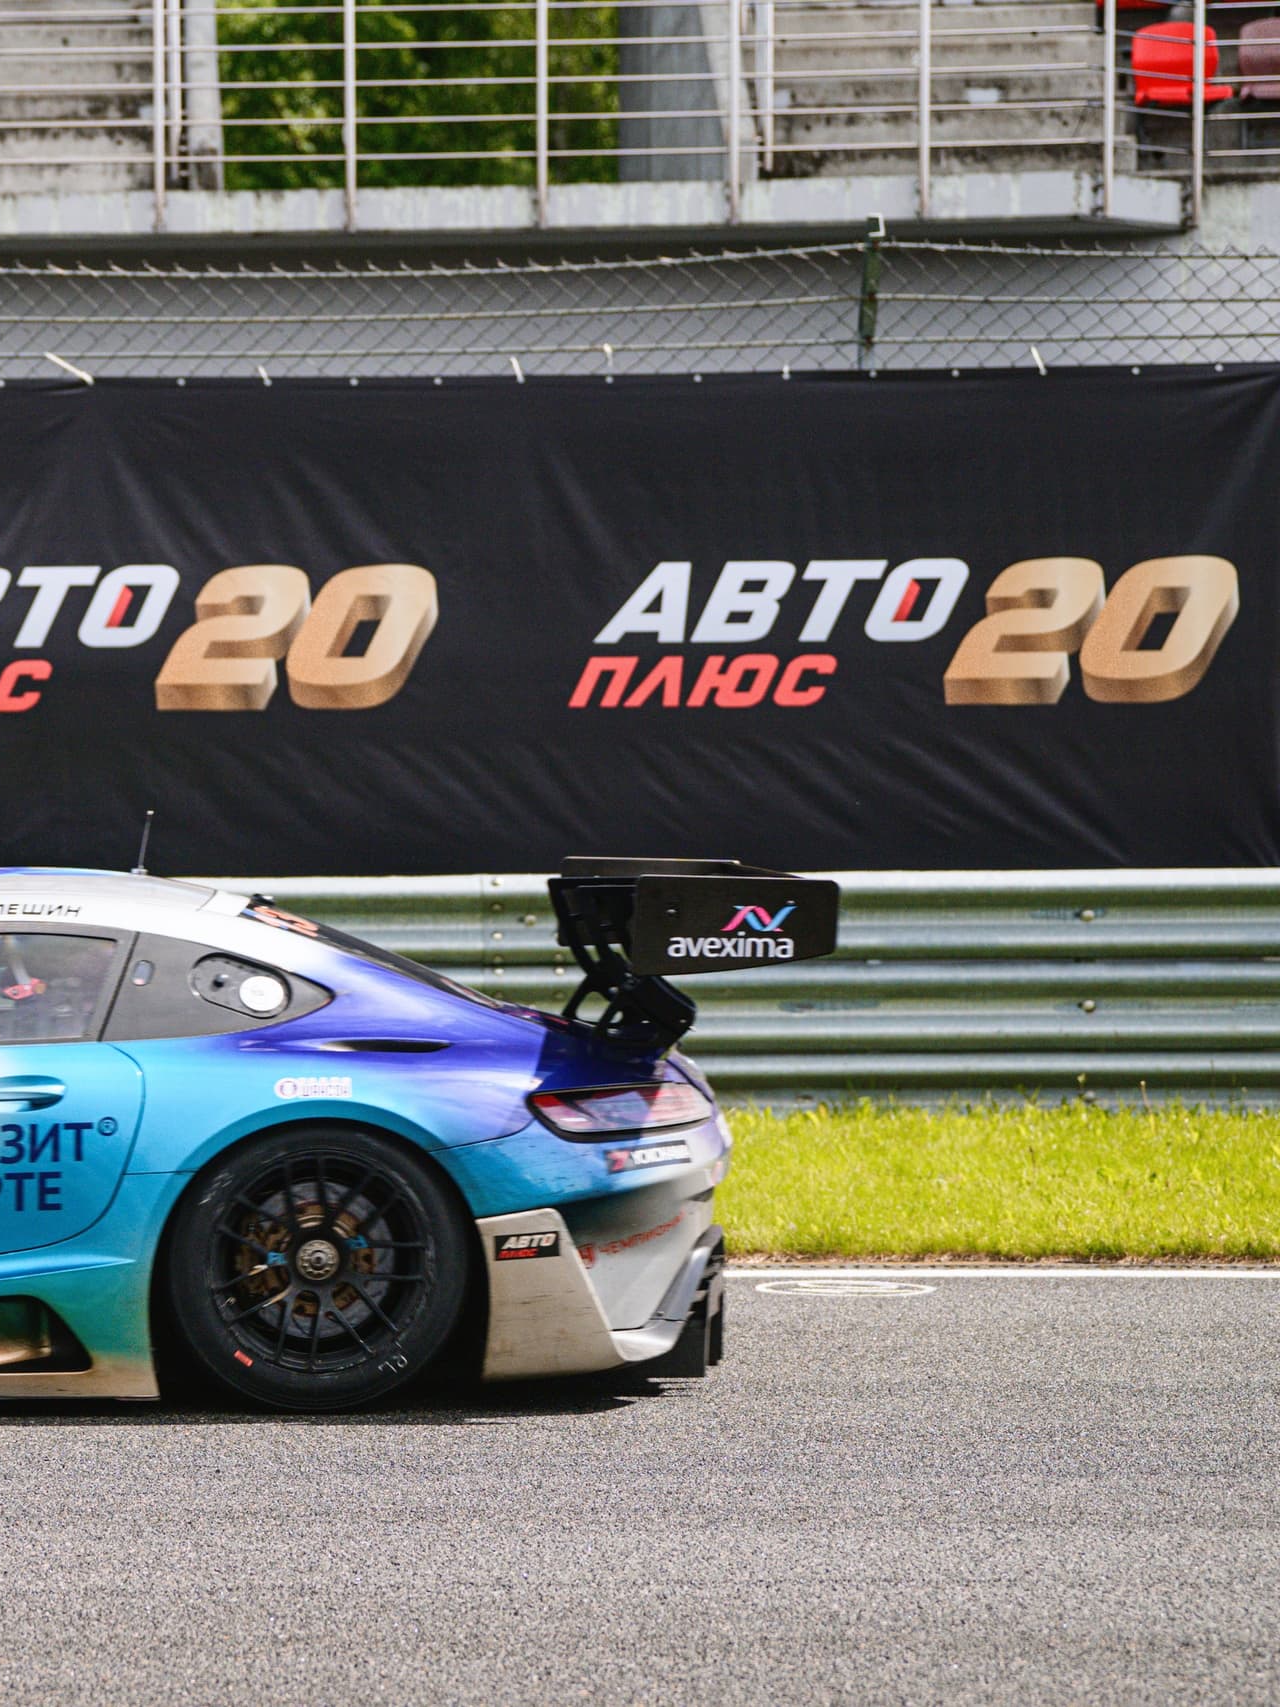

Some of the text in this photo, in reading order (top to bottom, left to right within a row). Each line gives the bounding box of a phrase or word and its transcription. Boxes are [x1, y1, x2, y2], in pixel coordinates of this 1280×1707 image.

[592, 557, 969, 644] АВТО
[944, 554, 1239, 705] 20
[154, 563, 439, 712] 20
[567, 653, 838, 709] ПЛЮС
[667, 931, 795, 959] avexima
[501, 1233, 557, 1250] АВТО
